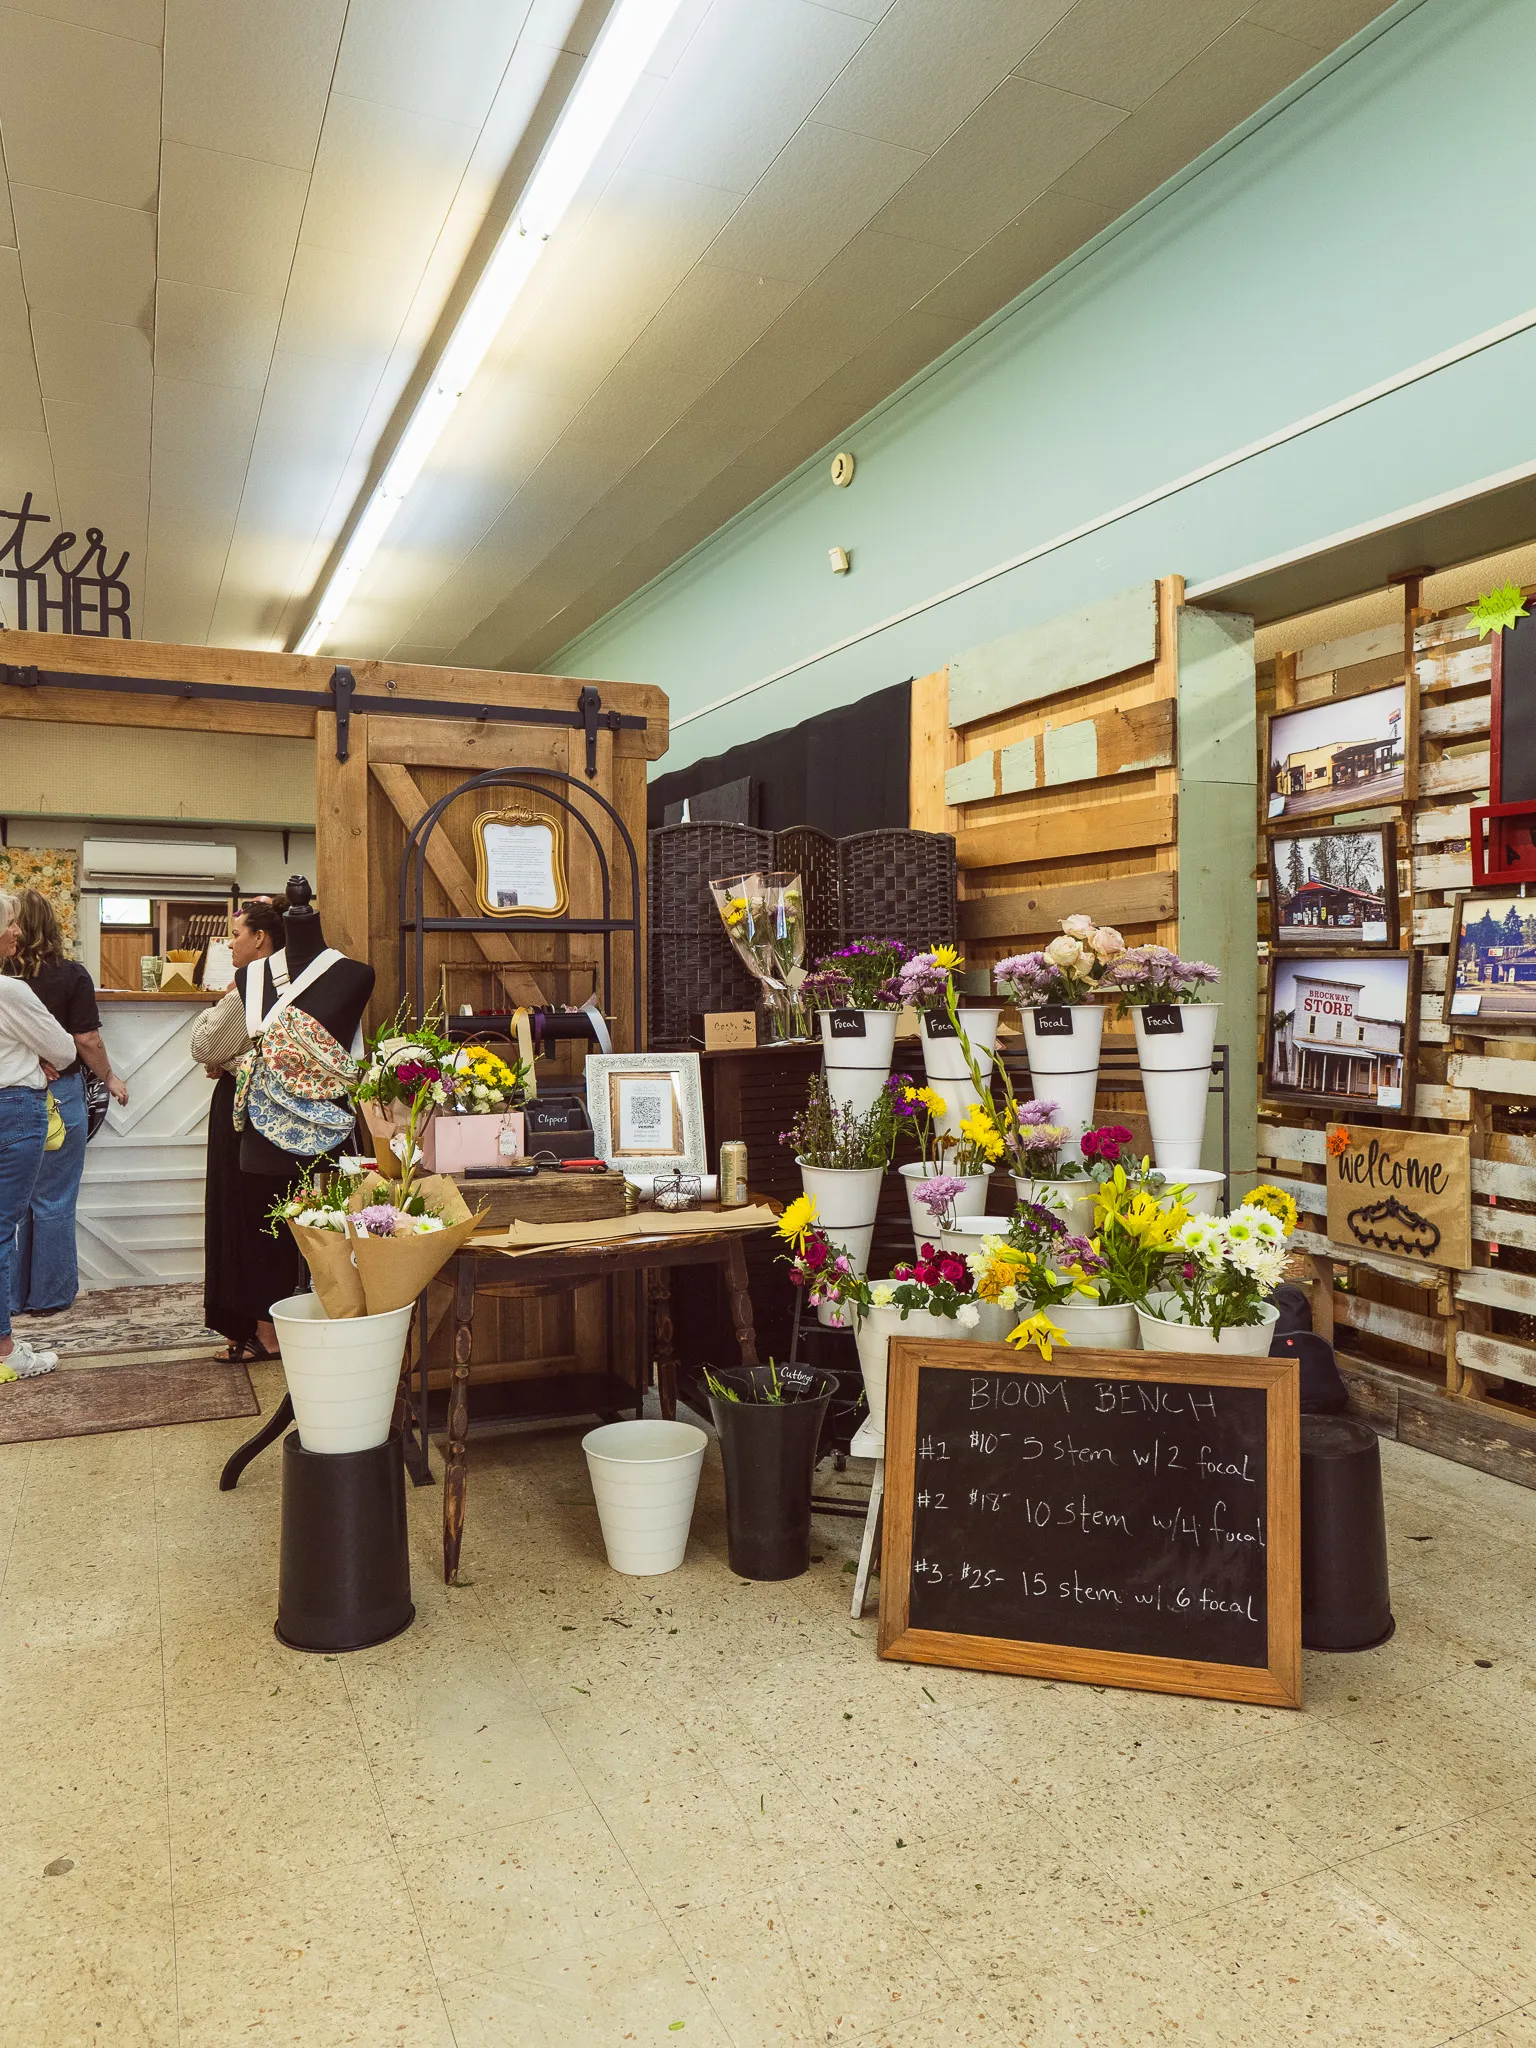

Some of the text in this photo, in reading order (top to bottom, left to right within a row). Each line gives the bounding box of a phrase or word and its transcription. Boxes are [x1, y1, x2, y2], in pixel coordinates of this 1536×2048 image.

[0, 492, 130, 580] ter
[0, 569, 131, 639] THER
[1304, 998, 1353, 1017] STORE
[1309, 990, 1350, 1003] BROCKWAY
[834, 1018, 859, 1029] Focal
[930, 1019, 954, 1032] Foca
[1038, 1016, 1068, 1029] Focal
[1146, 1015, 1175, 1027] Focal
[538, 1113, 568, 1127] Clippers
[1338, 1138, 1449, 1195] welcome
[1094, 1382, 1217, 1422] BENCH
[1022, 1436, 1044, 1461] 5
[1054, 1434, 1120, 1467] stem
[1195, 1445, 1255, 1482] focal
[917, 1489, 949, 1509] #2
[1025, 1498, 1051, 1527] 10
[1056, 1494, 1134, 1537] stem
[1022, 1571, 1048, 1596] 15
[1059, 1570, 1123, 1604] stem
[1199, 1588, 1258, 1621] focal
